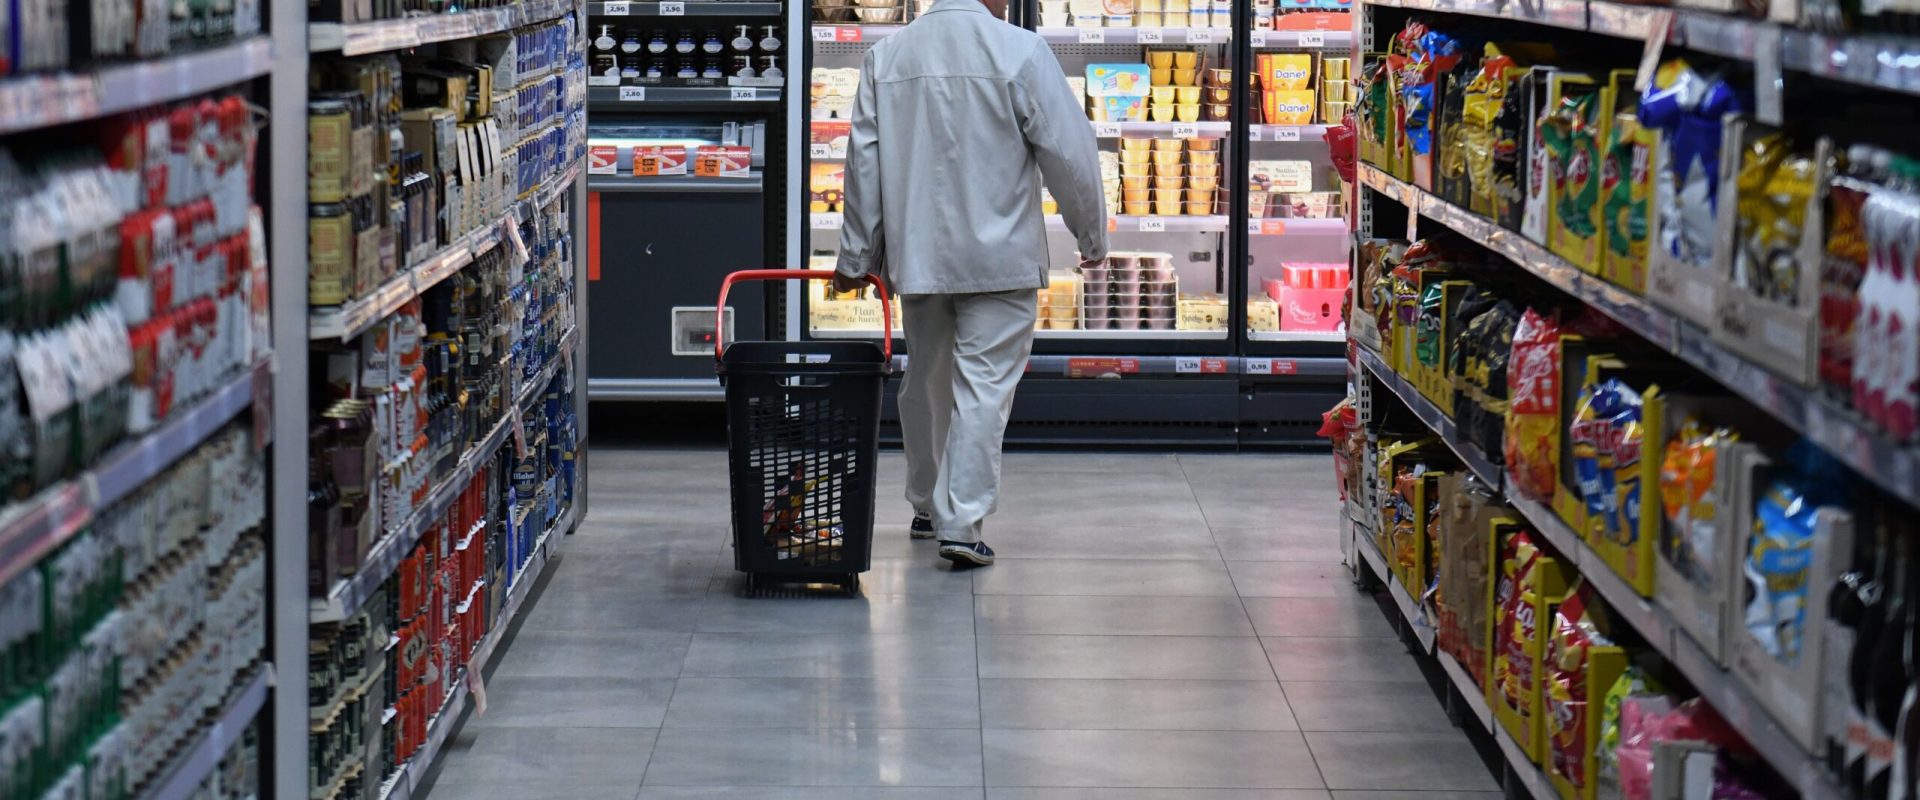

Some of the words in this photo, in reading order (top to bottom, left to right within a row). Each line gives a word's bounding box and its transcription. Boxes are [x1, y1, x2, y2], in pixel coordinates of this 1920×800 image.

[1275, 69, 1306, 80] Danet
[1279, 103, 1310, 113] Danet
[853, 306, 875, 316] Flan
